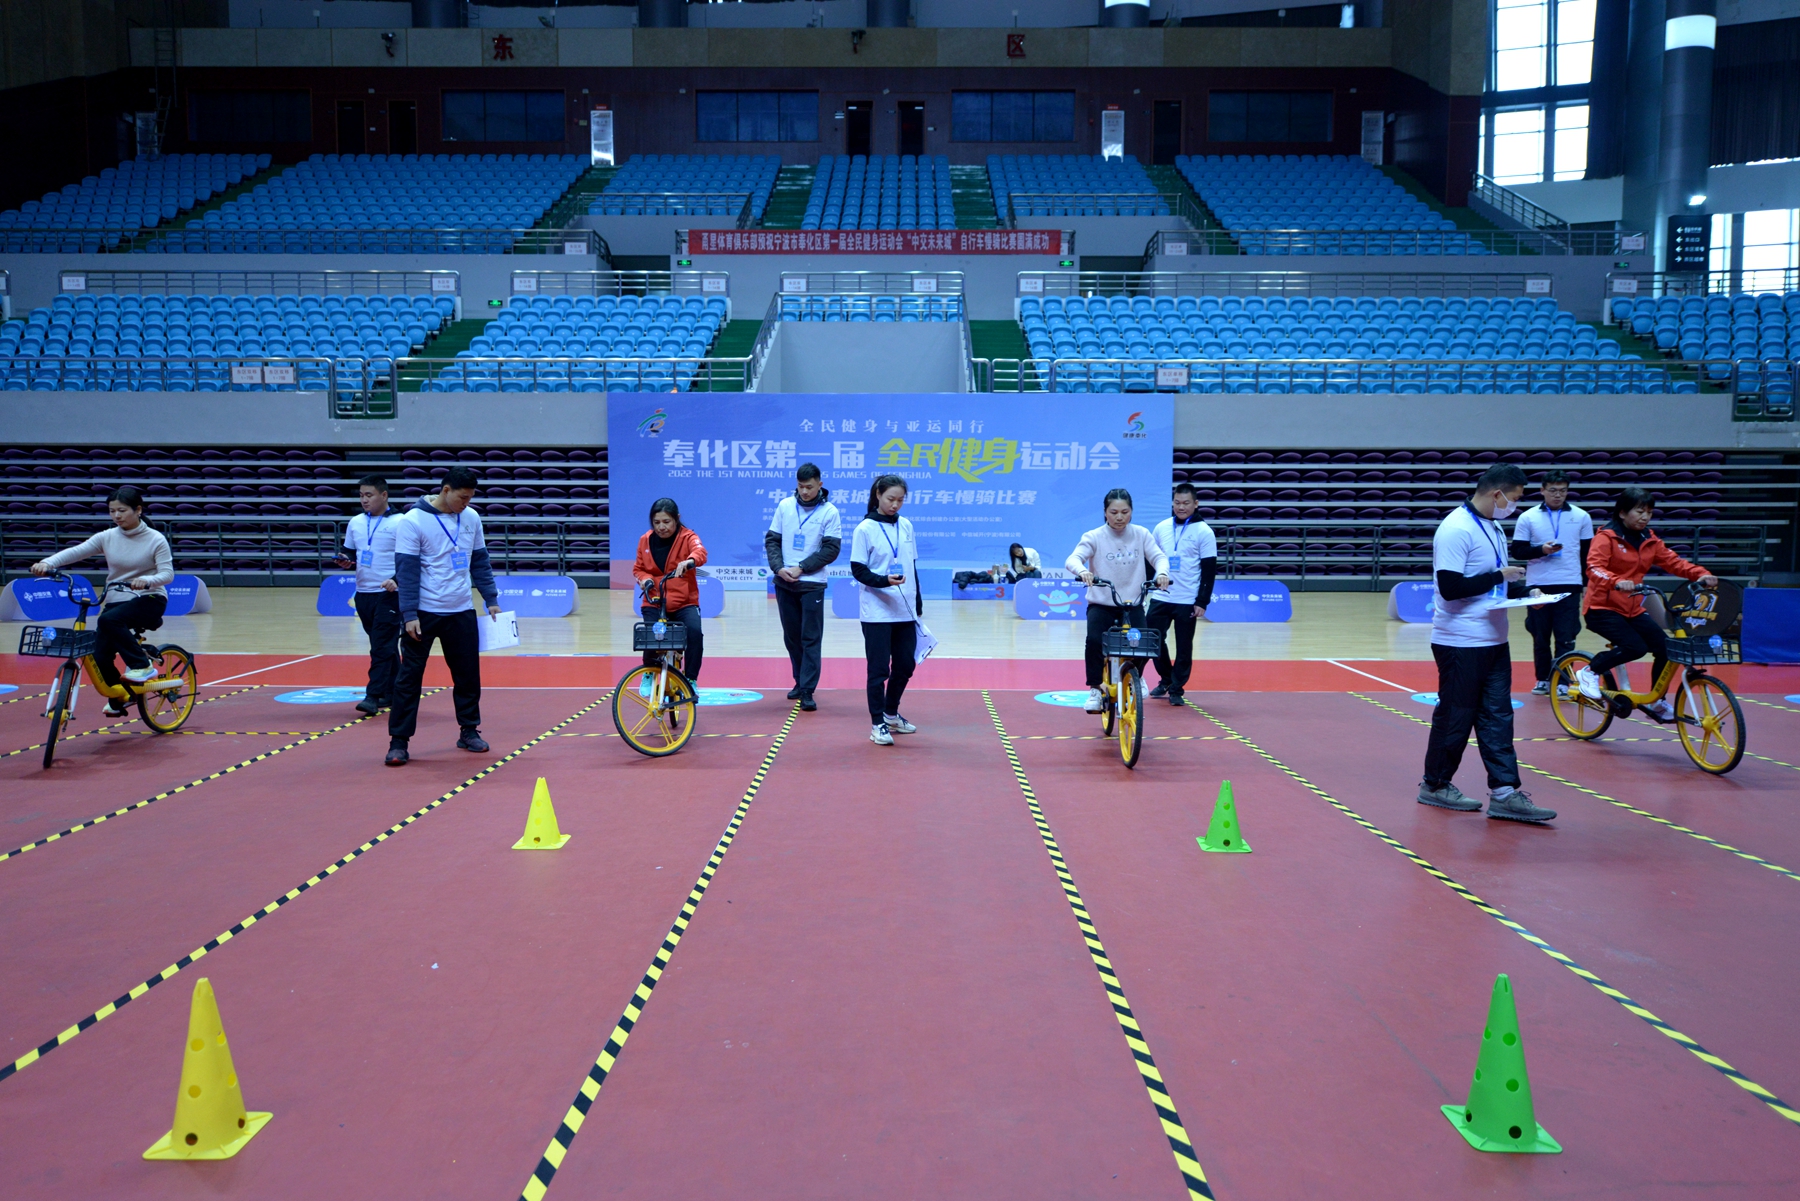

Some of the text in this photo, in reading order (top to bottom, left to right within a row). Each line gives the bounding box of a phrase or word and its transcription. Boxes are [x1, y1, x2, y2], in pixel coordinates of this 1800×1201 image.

[492, 34, 514, 60] 东
[1007, 34, 1026, 58] 区
[799, 418, 985, 434] 全民健身与亚运同行
[668, 470, 692, 478] 2022
[696, 470, 714, 478] THE
[738, 470, 785, 478] NATIONAL
[833, 471, 867, 479] GAMES
[995, 586, 1005, 598] 3
